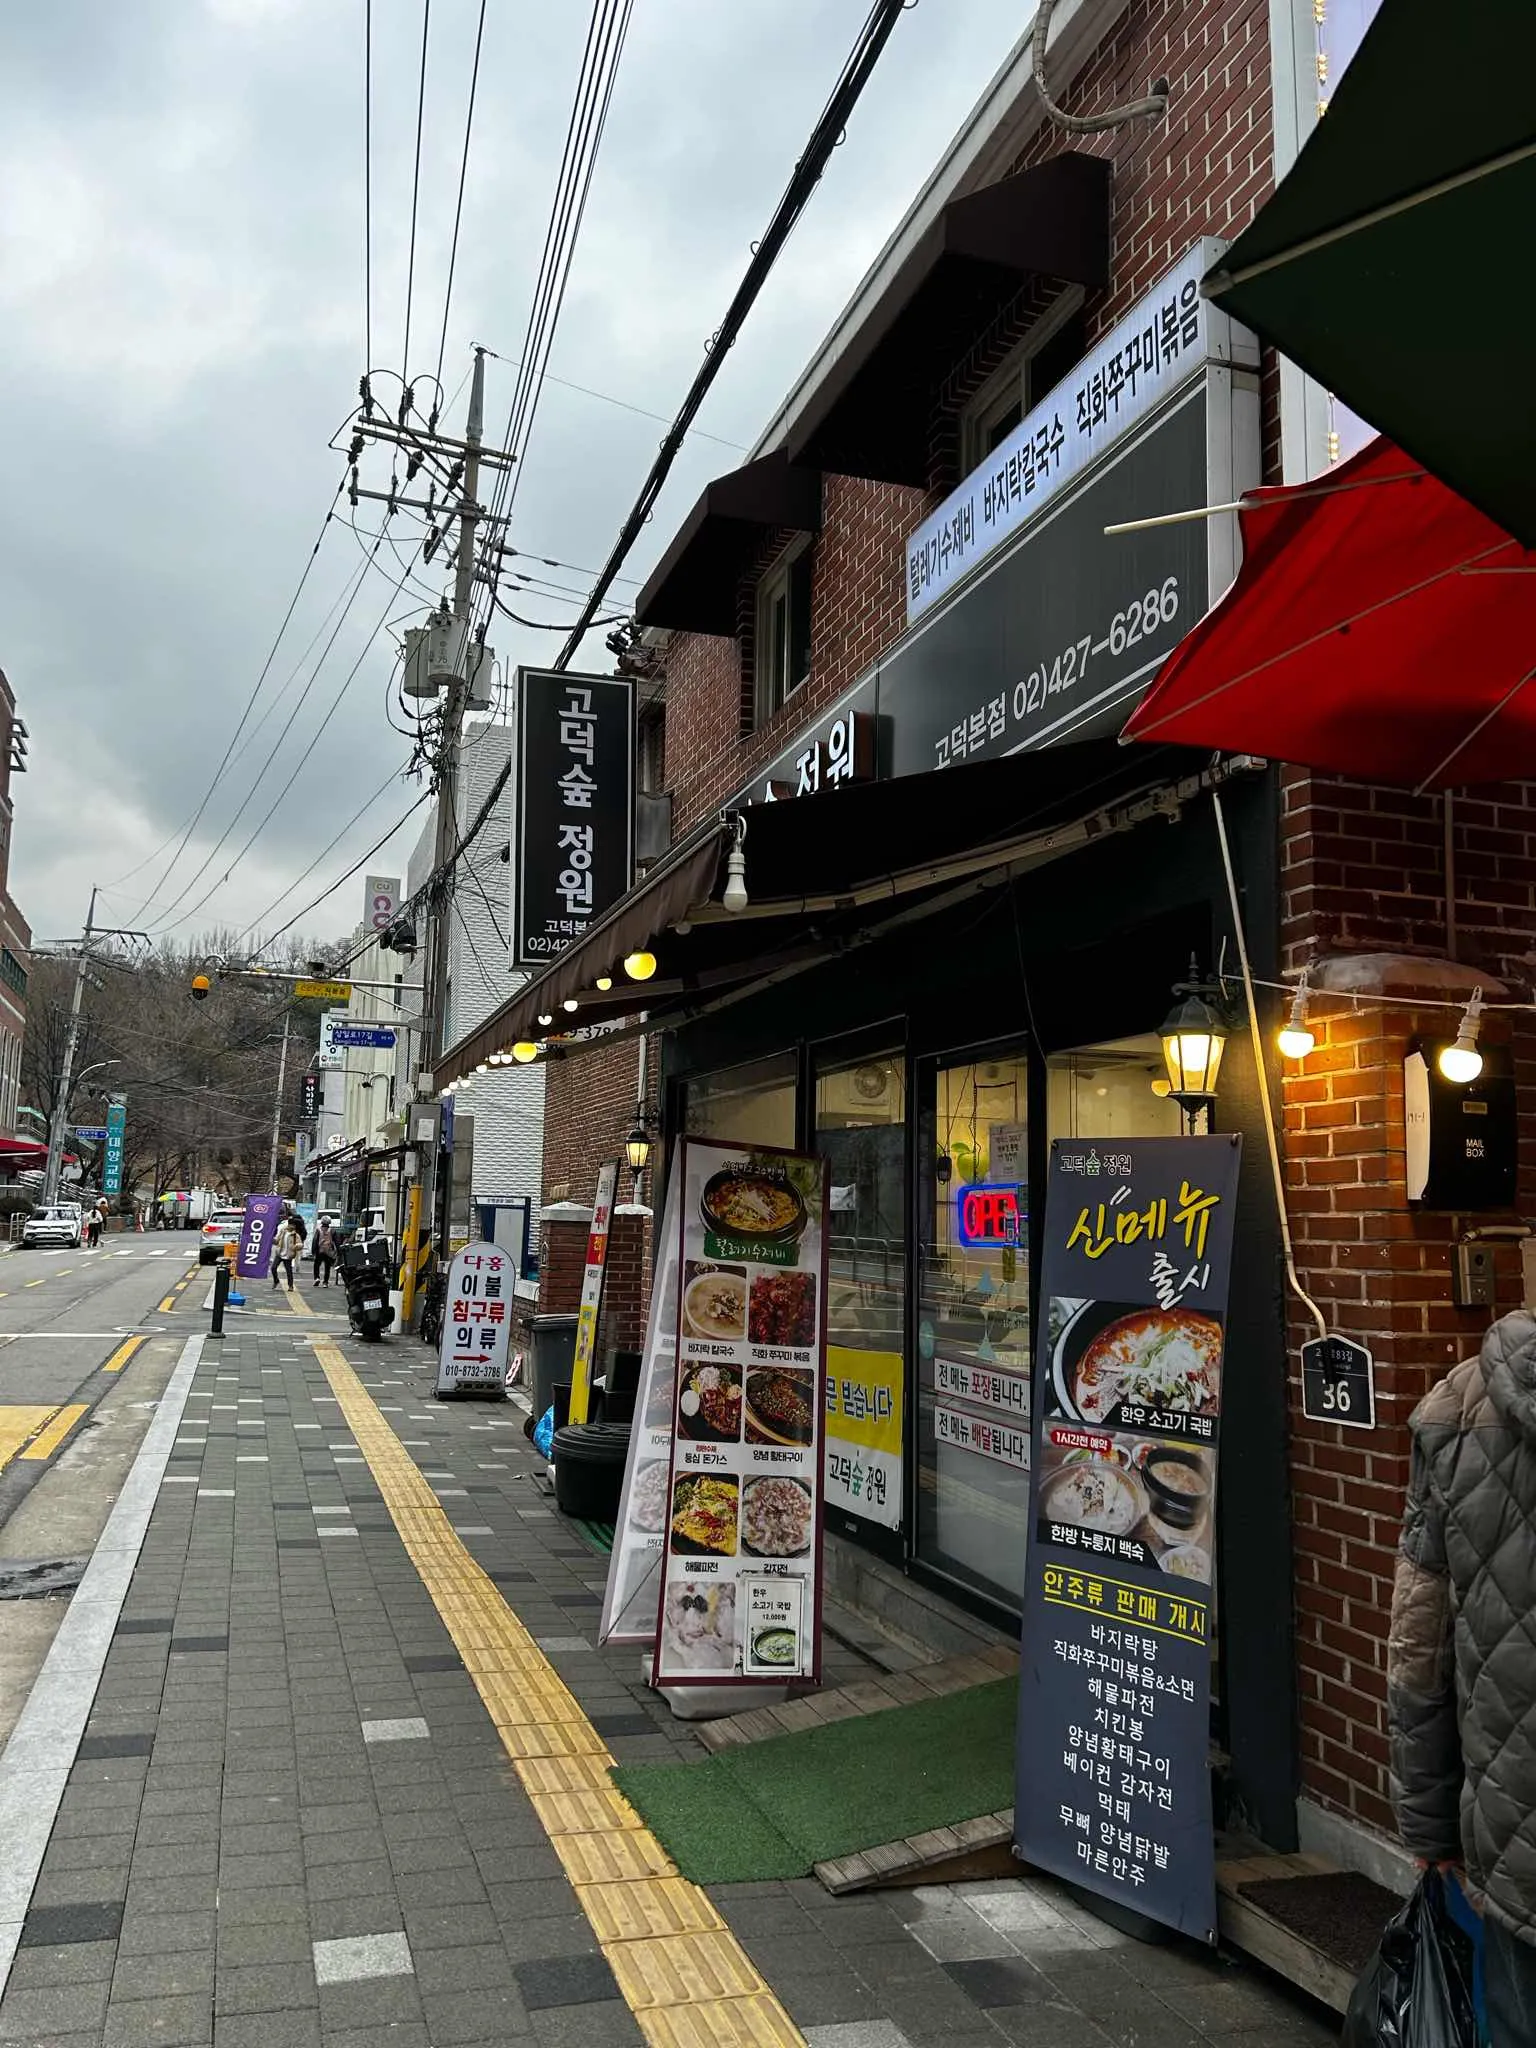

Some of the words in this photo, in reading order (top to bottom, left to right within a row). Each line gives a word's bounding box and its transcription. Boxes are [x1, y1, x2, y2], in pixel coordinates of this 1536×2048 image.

[910, 496, 975, 600] 털레기수제비
[984, 412, 1064, 527] 바지락칼국수
[1077, 279, 1200, 437] 직화쭈꾸미볶음
[934, 691, 1006, 771] 고덕본점
[1013, 576, 1179, 719] 02)427-6286
[557, 687, 598, 808] 고덕숲
[556, 824, 593, 914] 정원
[544, 920, 593, 935] 고덕본
[527, 937, 574, 952] 02)42
[1466, 1138, 1485, 1148] MAIL
[1466, 1148, 1485, 1158] BOX
[1103, 1155, 1132, 1176] 정원
[1066, 1180, 1220, 1260] 신메뉴
[244, 1220, 264, 1265] OPEN
[464, 1255, 505, 1272] 다홍
[461, 1274, 502, 1298] 이불
[1149, 1252, 1210, 1312] 출시
[453, 1300, 505, 1324] 침구류
[455, 1327, 497, 1350] 의류
[688, 1343, 711, 1354] 바지락
[751, 1348, 768, 1359] 직화
[793, 1351, 811, 1361] 볶음
[971, 1372, 1027, 1411] 포장됩니다.
[1322, 1379, 1351, 1411] 36
[1121, 1406, 1145, 1424] 한우
[1148, 1411, 1187, 1432] 소고기
[1190, 1416, 1212, 1436] 국밥
[752, 1450, 769, 1462] 양념
[770, 1451, 803, 1463] 황태구이
[971, 1423, 1028, 1465] 배달됩니다.
[1056, 1432, 1088, 1447] 1시간전
[1090, 1437, 1108, 1450] 예약
[685, 1453, 700, 1465] 등심
[702, 1454, 728, 1465] 돈가스
[1051, 1524, 1078, 1544] 한방
[1081, 1531, 1116, 1554] 누룽지
[1119, 1540, 1145, 1561] 백숙
[685, 1561, 719, 1573] 해물파전
[763, 1563, 788, 1575] 감자전
[752, 1588, 767, 1598] 한우
[752, 1601, 774, 1610] 소고기
[776, 1601, 792, 1610] 국밥
[1043, 1570, 1104, 1606] 안주류
[1116, 1588, 1156, 1621] 판매
[1169, 1602, 1206, 1636] 개시
[1091, 1624, 1158, 1661] 바지락탕
[1088, 1677, 1154, 1718] 해물파전
[1094, 1707, 1145, 1742] 치킨봉
[1068, 1725, 1170, 1780] 양념황태구이
[1063, 1751, 1111, 1787] 베이컨
[1120, 1772, 1173, 1810] 감자전
[1098, 1792, 1131, 1823] 먹태
[1100, 1822, 1170, 1869] 양념닭발
[1077, 1841, 1146, 1887] 마른안주
